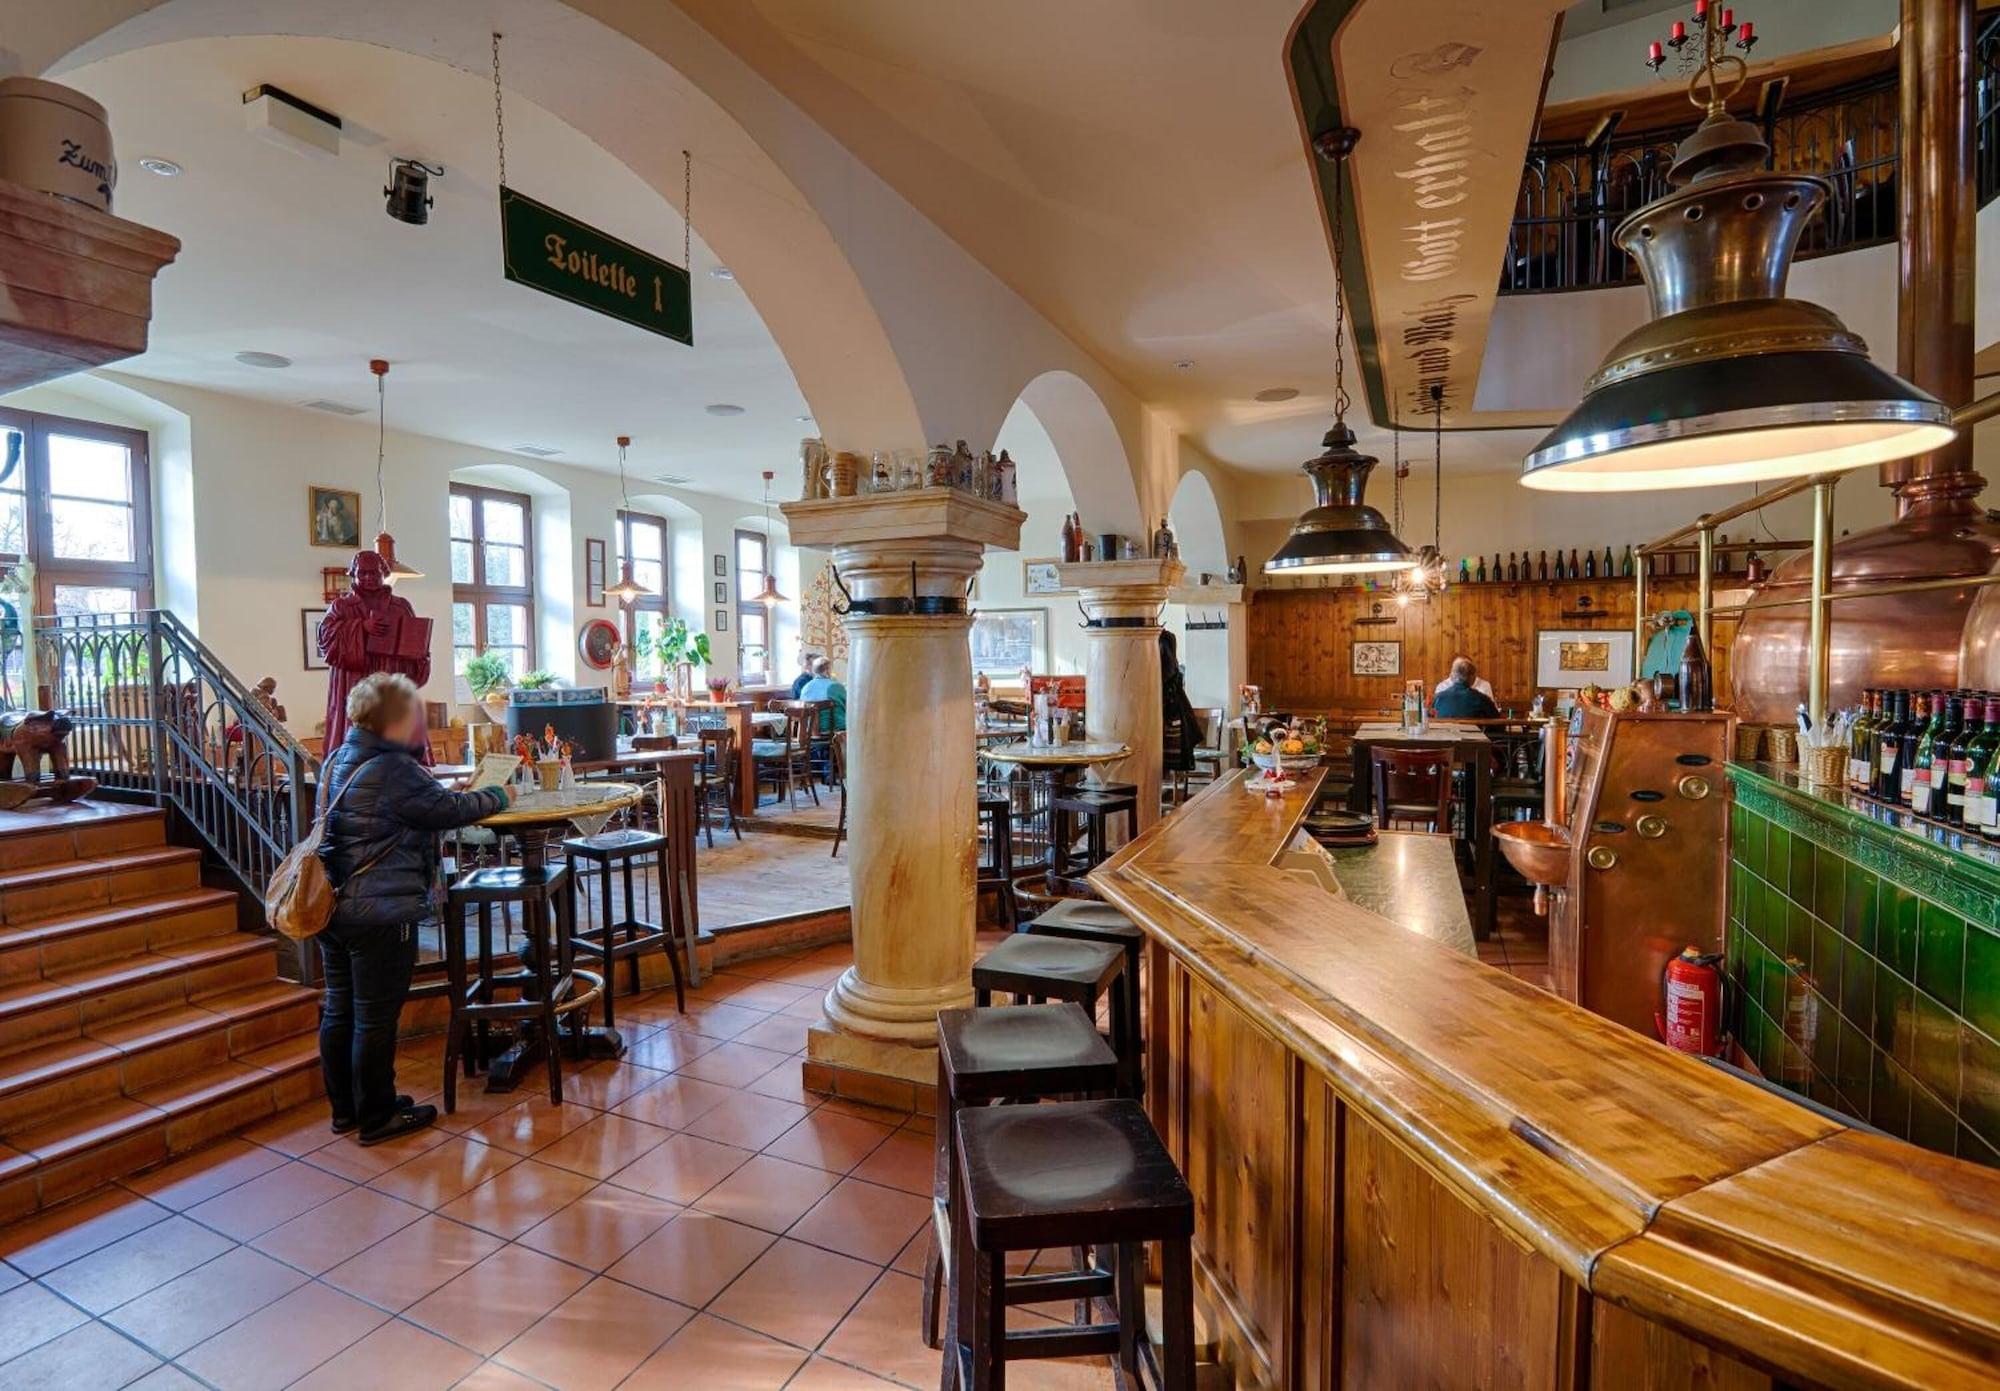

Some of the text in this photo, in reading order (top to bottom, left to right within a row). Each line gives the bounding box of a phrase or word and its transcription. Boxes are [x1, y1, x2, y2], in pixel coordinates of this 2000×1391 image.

[544, 234, 637, 298] Toilette
[1400, 217, 1465, 281] Gott
[1402, 294, 1478, 346] Malz
[1403, 347, 1452, 374] und
